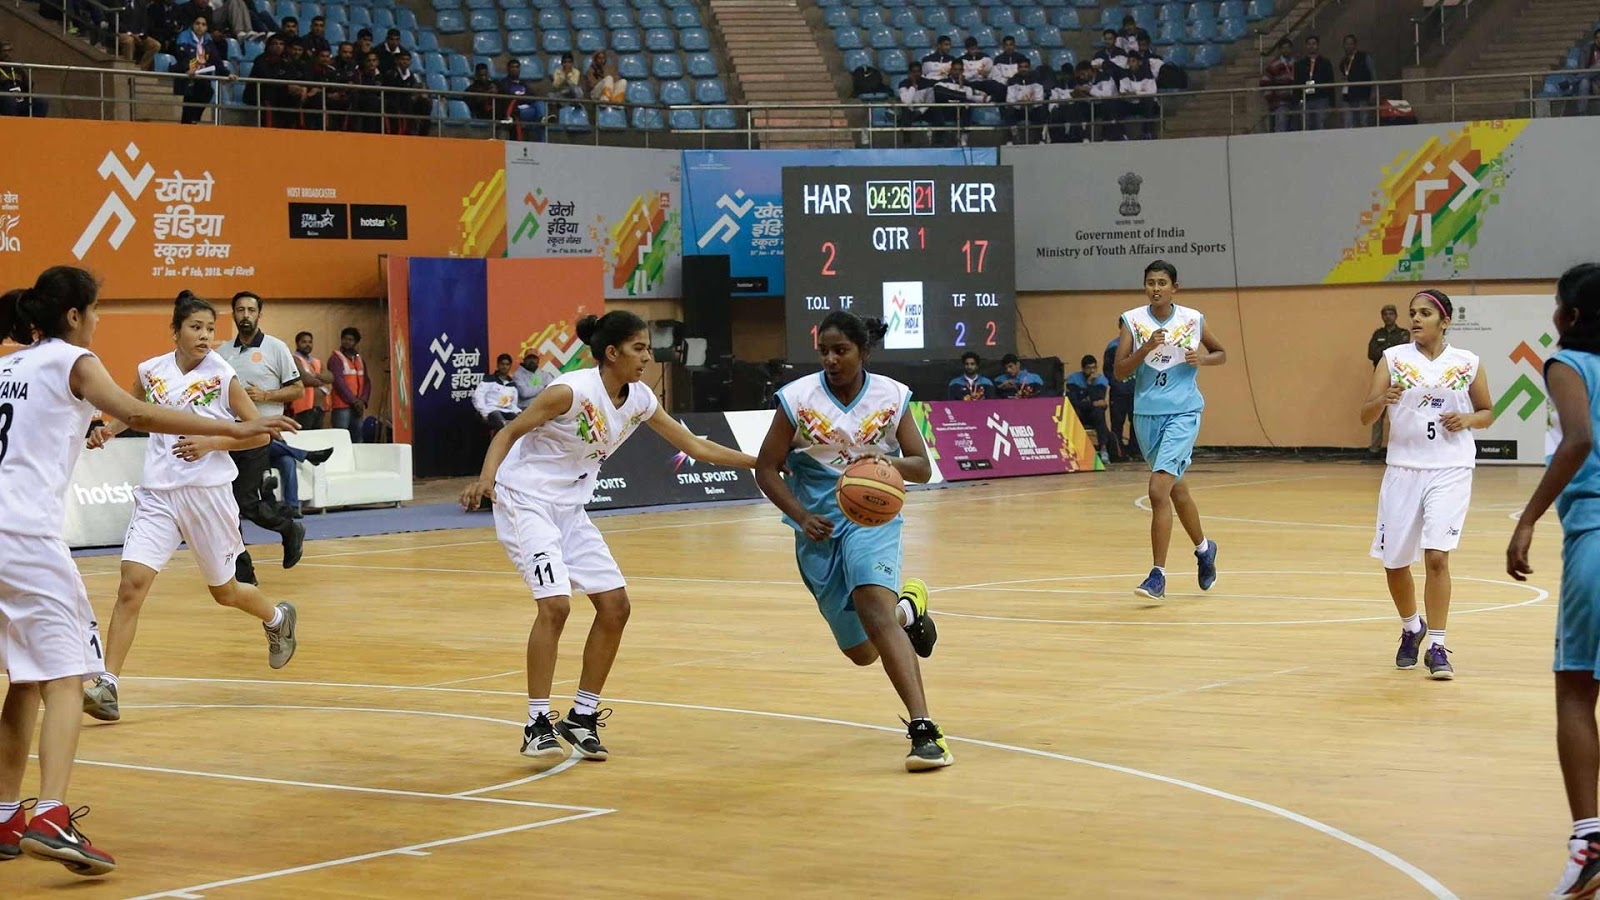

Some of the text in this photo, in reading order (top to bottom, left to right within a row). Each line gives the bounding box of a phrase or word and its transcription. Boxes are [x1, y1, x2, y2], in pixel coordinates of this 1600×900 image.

[155, 170, 215, 203] खेलो
[803, 184, 852, 214] HAR
[868, 186, 910, 209] 04:26
[915, 186, 932, 209] 21
[951, 183, 996, 213] KER
[301, 213, 317, 221] STAR
[548, 201, 575, 217] खेलो
[754, 201, 783, 218] खेल
[153, 204, 225, 240] इंडिया
[301, 220, 324, 229] SPORTS
[360, 217, 385, 227] hotstar
[547, 217, 579, 235] इंडिया
[752, 219, 783, 237] इंडि
[547, 236, 565, 247] स्कूल
[872, 227, 926, 251] QTR 1
[1075, 227, 1185, 241] Government of India
[154, 239, 231, 265] स्कूल गेम्स
[751, 238, 779, 250] स्कूल
[1036, 242, 1226, 260] Ministry of Youth Affairs and Sports
[821, 241, 837, 276] 2
[961, 240, 989, 273] 17
[806, 295, 854, 310] T.O.L T.F
[952, 293, 998, 307] T.F T.O.L
[905, 304, 922, 315] KHELO
[904, 316, 919, 329] INDIA
[955, 322, 966, 347] 2
[986, 321, 997, 346] 2
[452, 348, 480, 368] खेलो
[451, 368, 485, 389] इंडिया
[1154, 372, 1167, 386] 13
[451, 390, 467, 402] स्कूल
[1009, 425, 1034, 437] KHELO
[1427, 422, 1436, 440] 5
[1013, 437, 1037, 449] INDIA
[677, 470, 739, 485] STAR SPORTS
[73, 482, 140, 505] hotst
[705, 486, 725, 495] Believe
[534, 562, 555, 586] 11
[90, 634, 102, 659] 1
